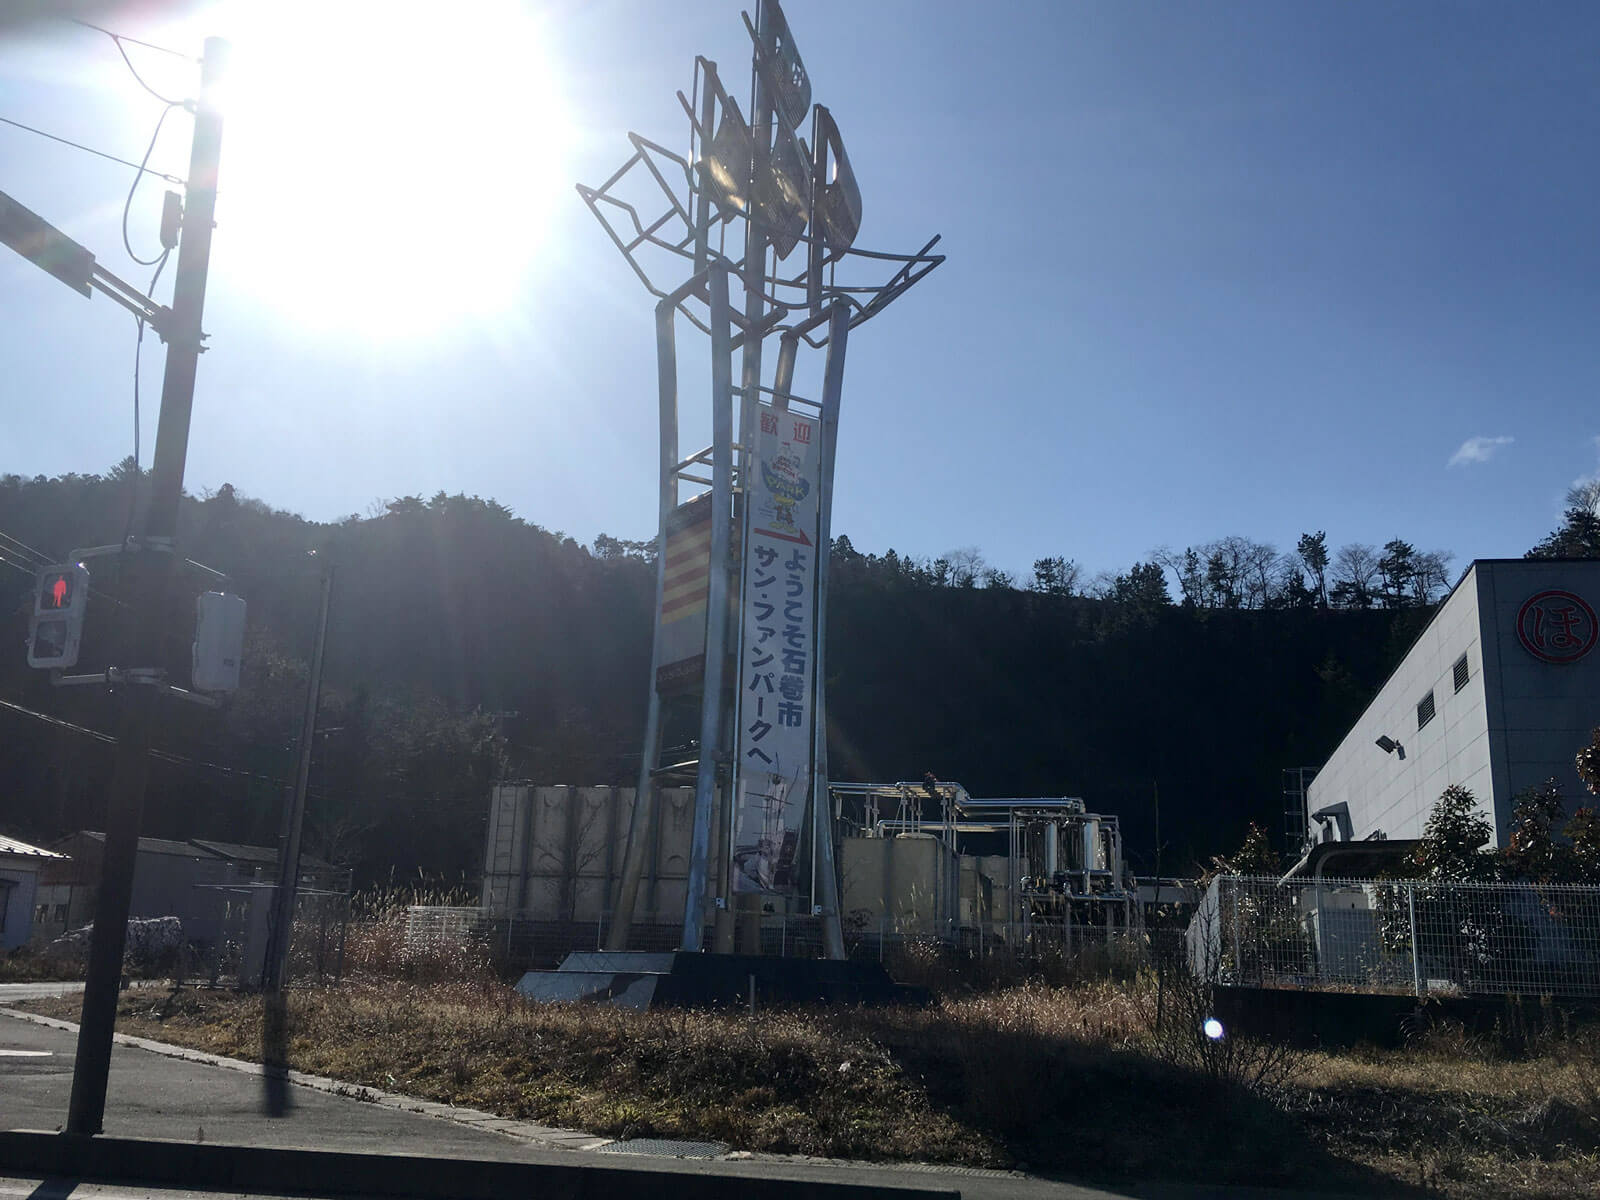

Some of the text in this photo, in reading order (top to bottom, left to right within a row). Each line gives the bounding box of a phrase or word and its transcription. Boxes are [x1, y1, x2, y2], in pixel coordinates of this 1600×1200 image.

[777, 548, 807, 728] ようこそ石巻市
